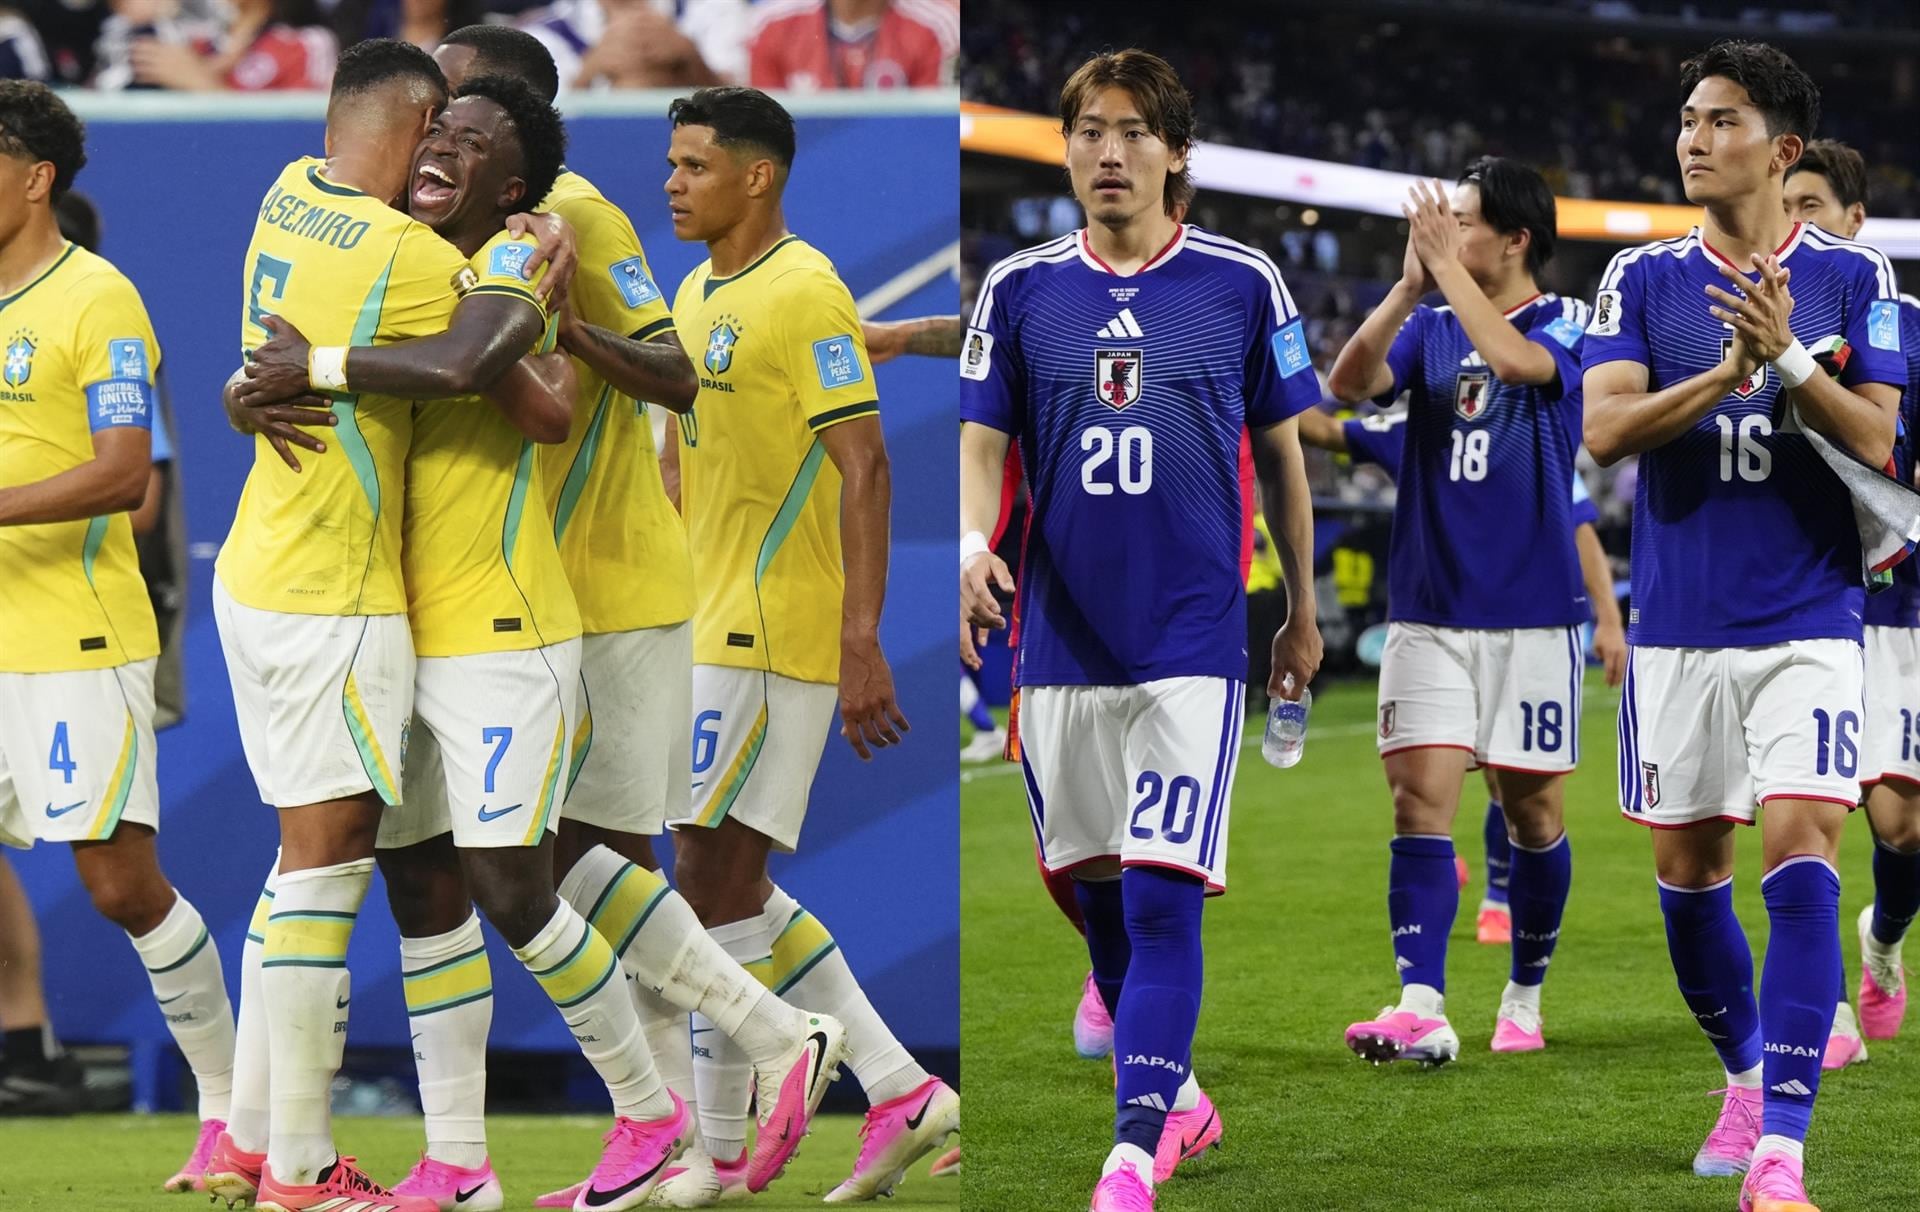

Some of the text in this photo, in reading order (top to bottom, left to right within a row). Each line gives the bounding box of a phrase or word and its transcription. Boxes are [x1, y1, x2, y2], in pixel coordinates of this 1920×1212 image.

[260, 185, 371, 250] ASEMIRO
[98, 382, 142, 395] FOOTBALL
[700, 378, 736, 393] BRASIL
[830, 364, 852, 378] PEACE
[98, 391, 144, 406] UNITES
[116, 403, 147, 416] World
[1081, 426, 1153, 496] 20
[1449, 429, 1490, 482] 18
[1715, 414, 1773, 482] 16
[49, 721, 77, 784] 4
[1520, 700, 1563, 753] 18
[1812, 707, 1860, 779] 16
[482, 726, 513, 793] 7
[1129, 769, 1201, 845] 20
[1763, 1042, 1819, 1059] JAPAN
